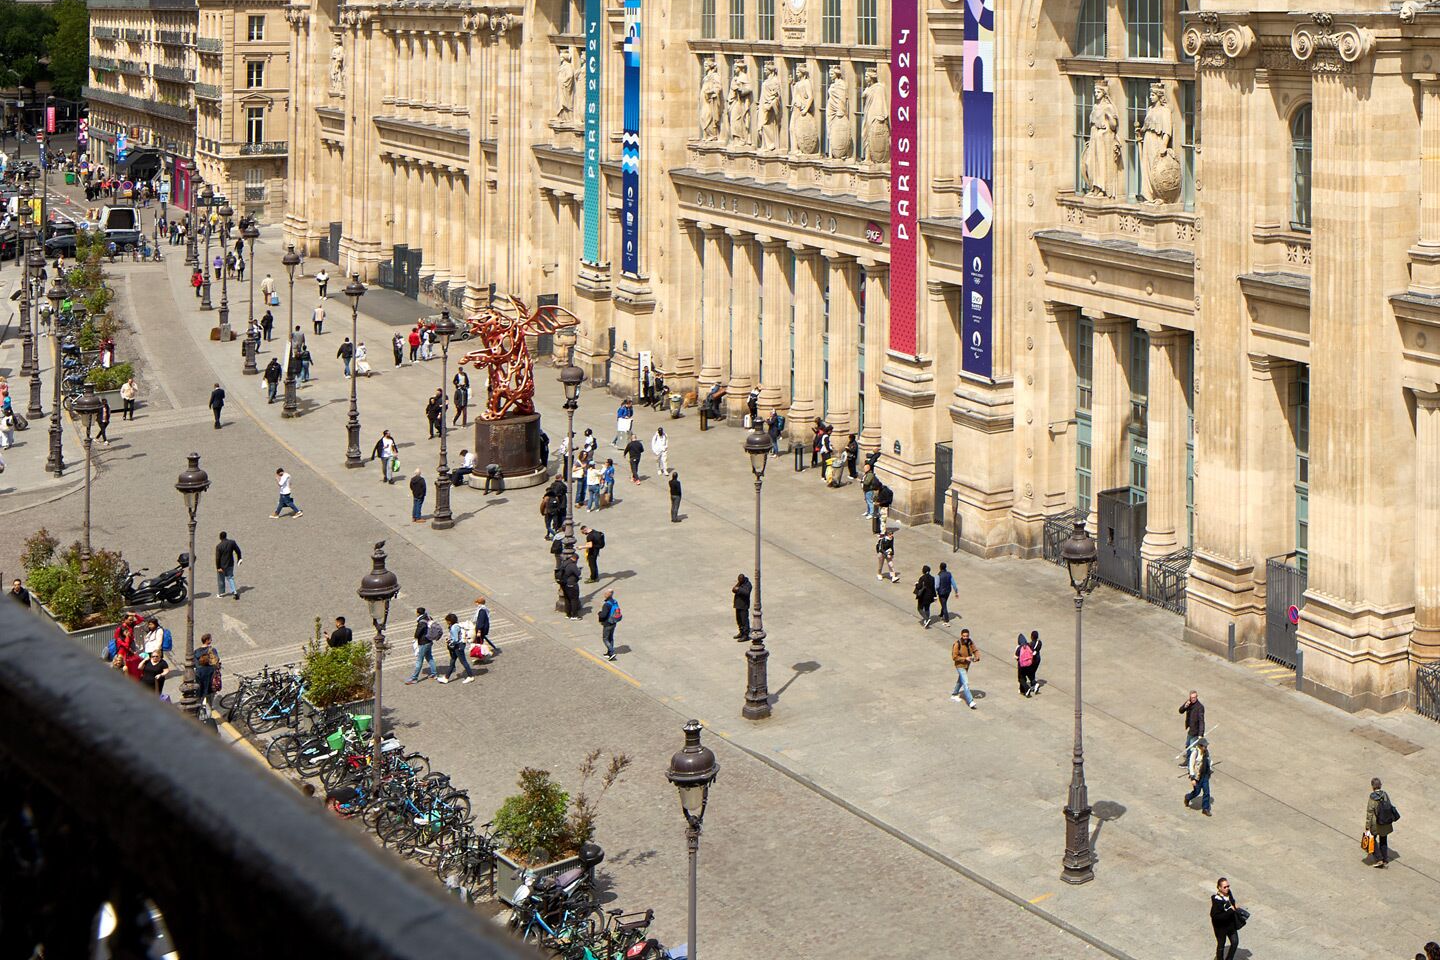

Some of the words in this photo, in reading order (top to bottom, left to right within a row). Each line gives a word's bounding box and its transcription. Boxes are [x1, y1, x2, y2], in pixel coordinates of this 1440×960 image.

[589, 22, 597, 90] 2024
[898, 29, 910, 121] 2024
[588, 102, 596, 178] PARIS
[697, 191, 739, 214] GARE
[752, 201, 772, 220] DU
[786, 207, 838, 234] NORD
[898, 137, 910, 240] PARIS
